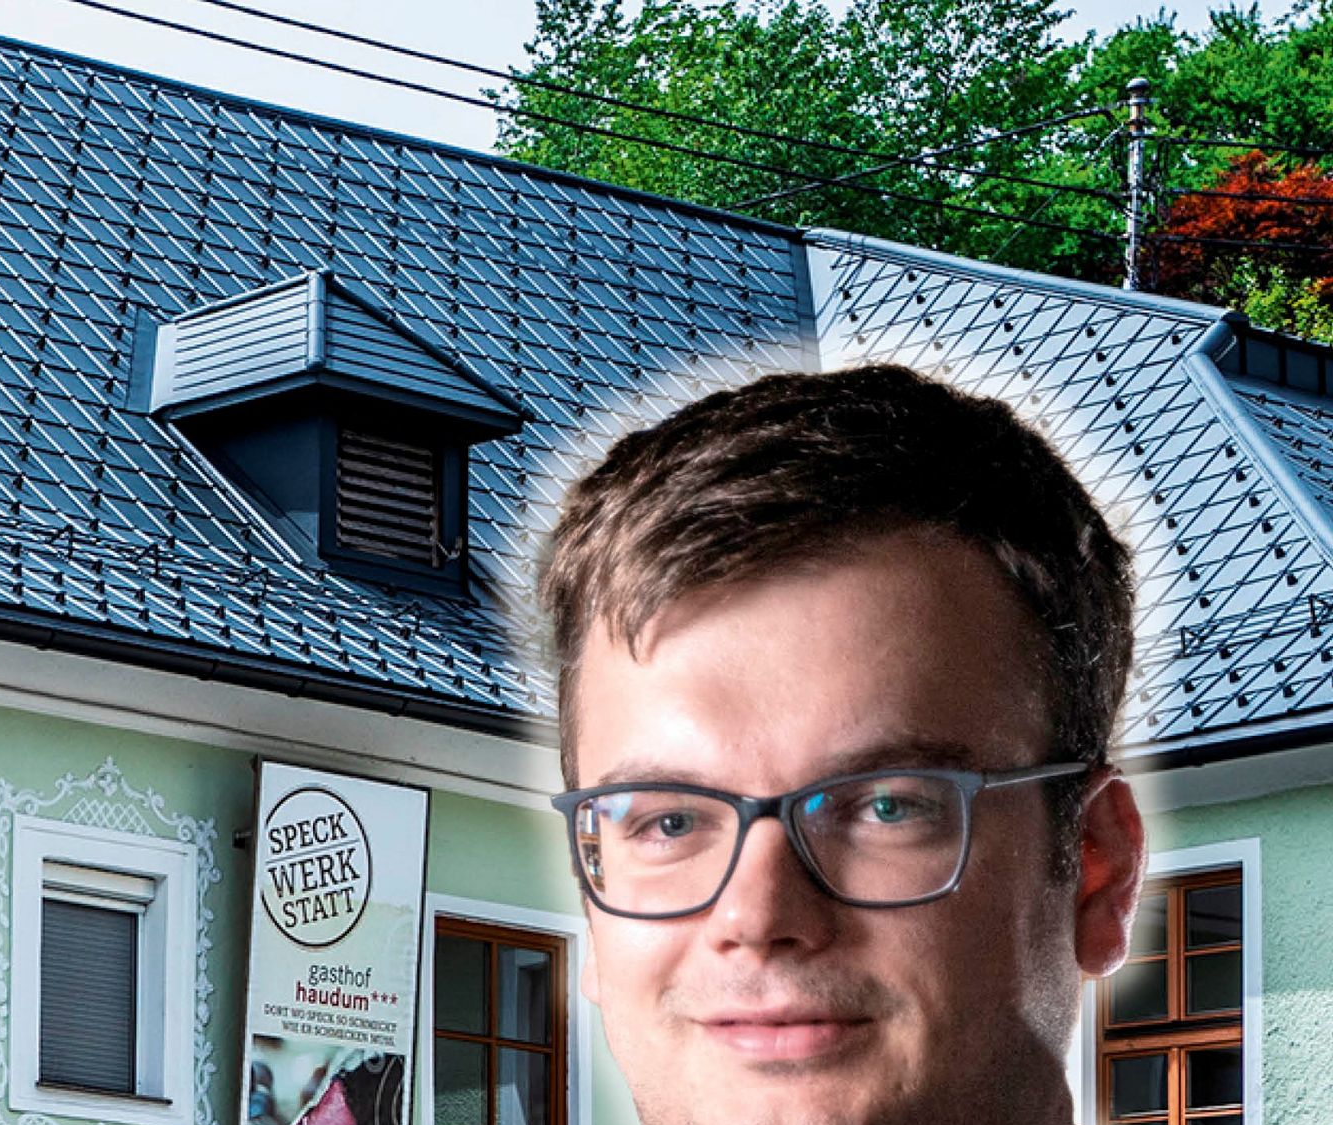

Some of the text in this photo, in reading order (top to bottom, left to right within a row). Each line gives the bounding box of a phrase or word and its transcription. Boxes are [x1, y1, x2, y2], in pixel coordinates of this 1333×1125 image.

[268, 812, 348, 854] SPECK
[267, 848, 361, 898] WERK
[283, 887, 355, 928] STATT
[308, 964, 372, 988] gasthof
